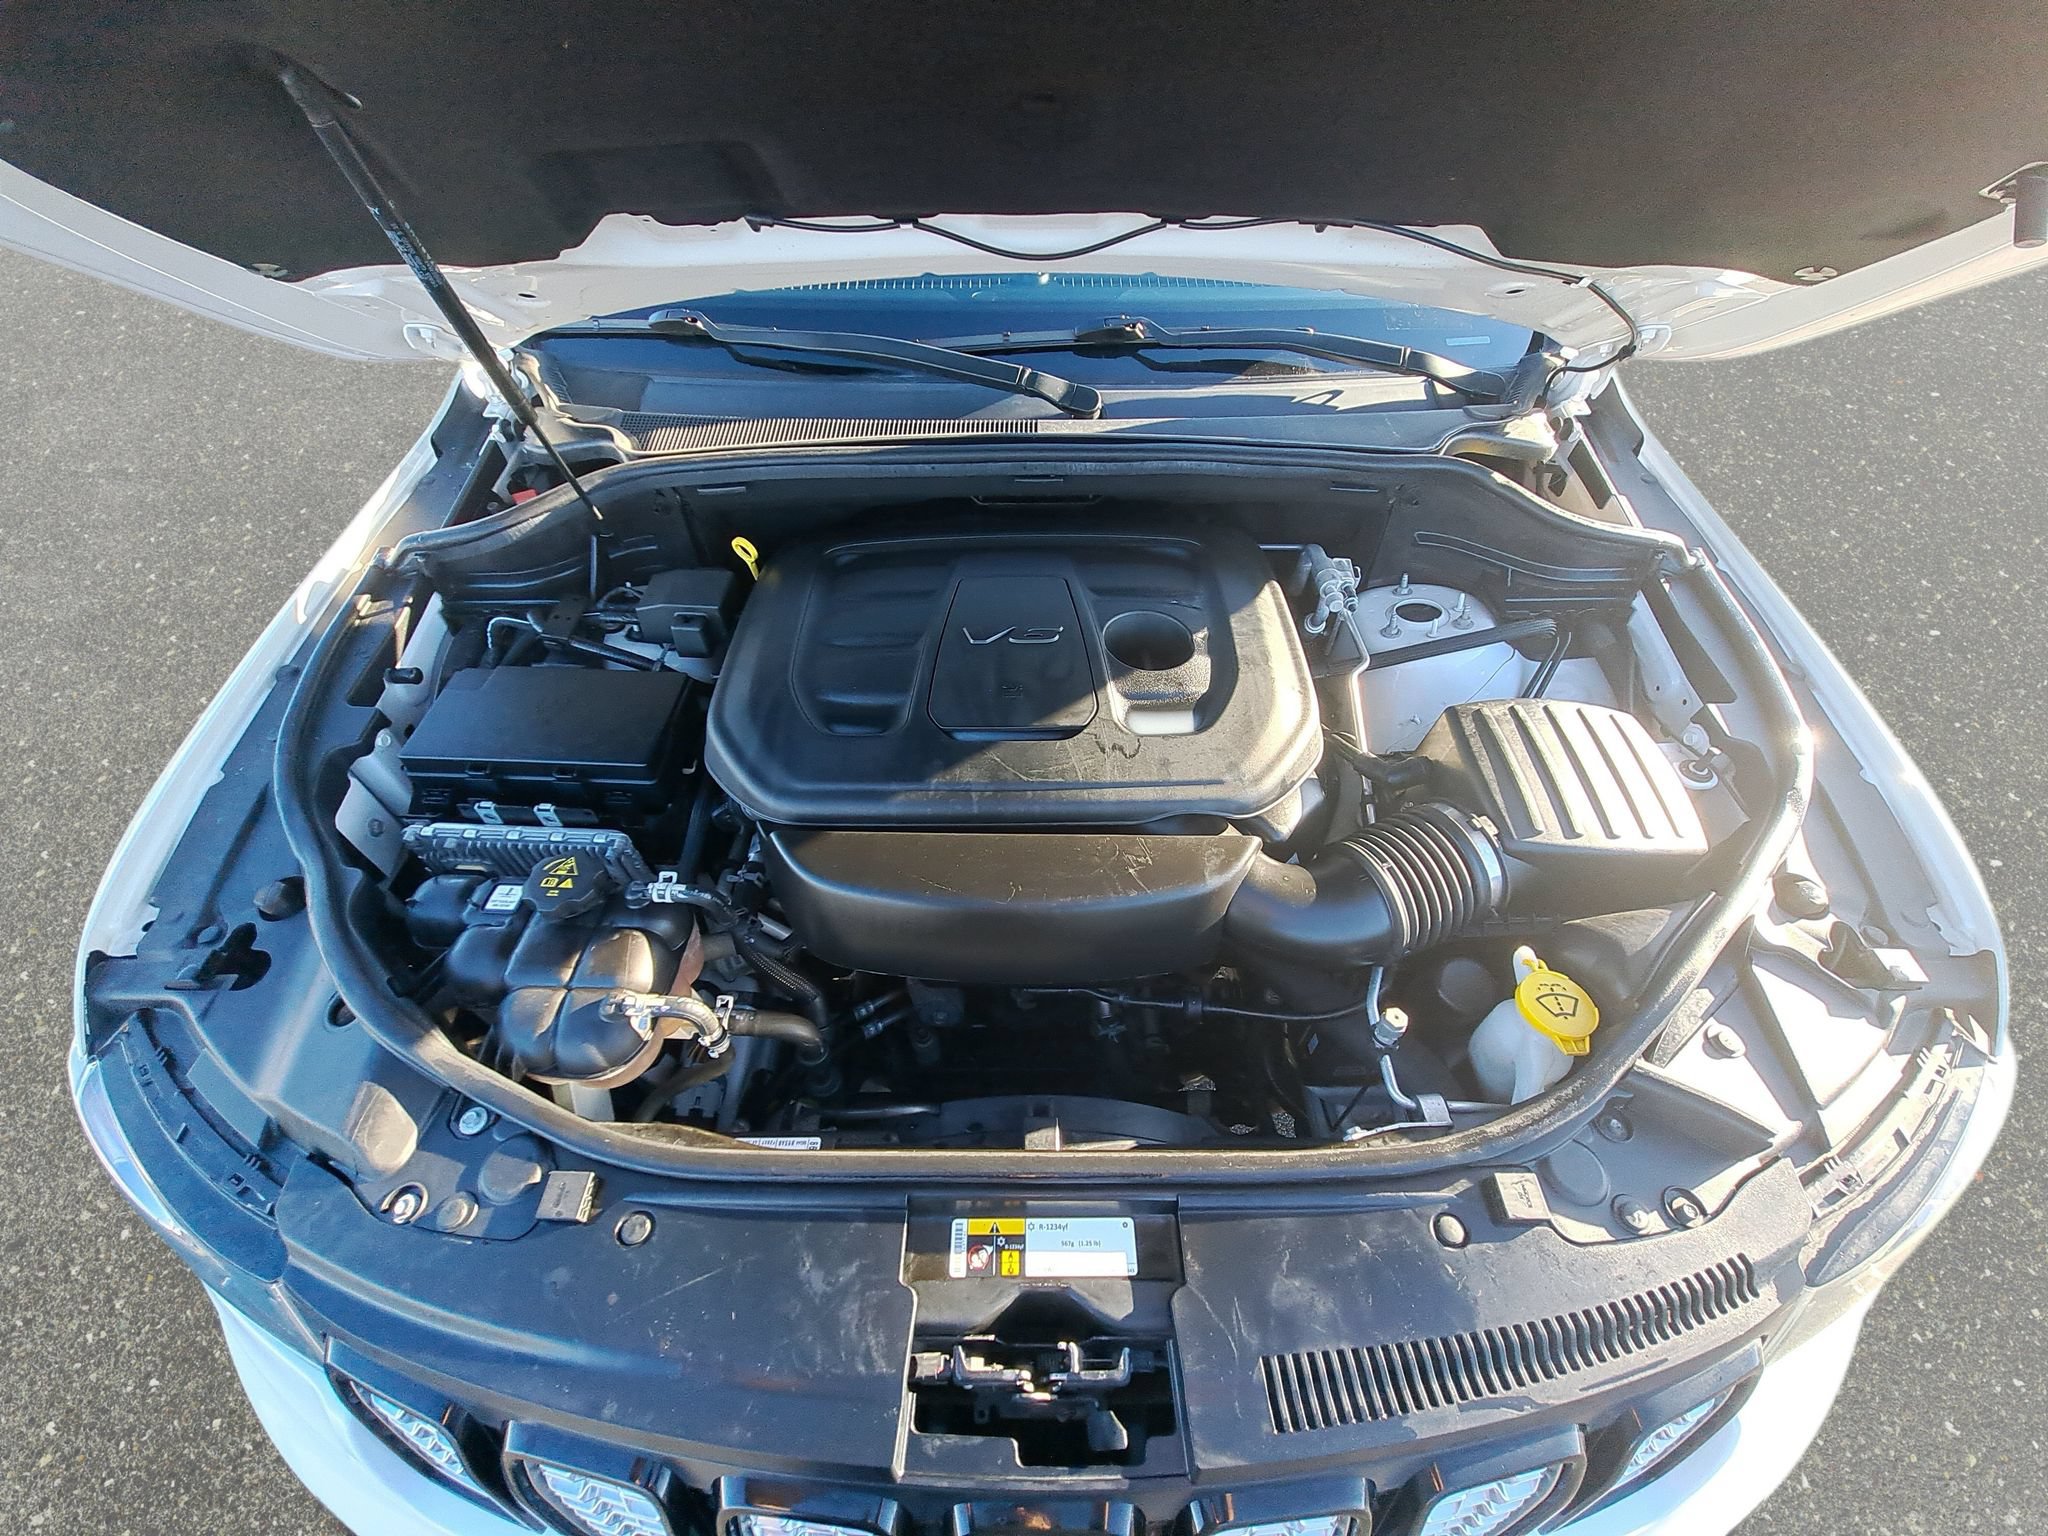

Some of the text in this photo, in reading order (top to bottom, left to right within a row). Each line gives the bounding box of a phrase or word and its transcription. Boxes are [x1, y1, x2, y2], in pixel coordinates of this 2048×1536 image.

[1038, 1222, 1069, 1232] R-1234yf
[1061, 1240, 1101, 1248] 567g (1.25 lb)
